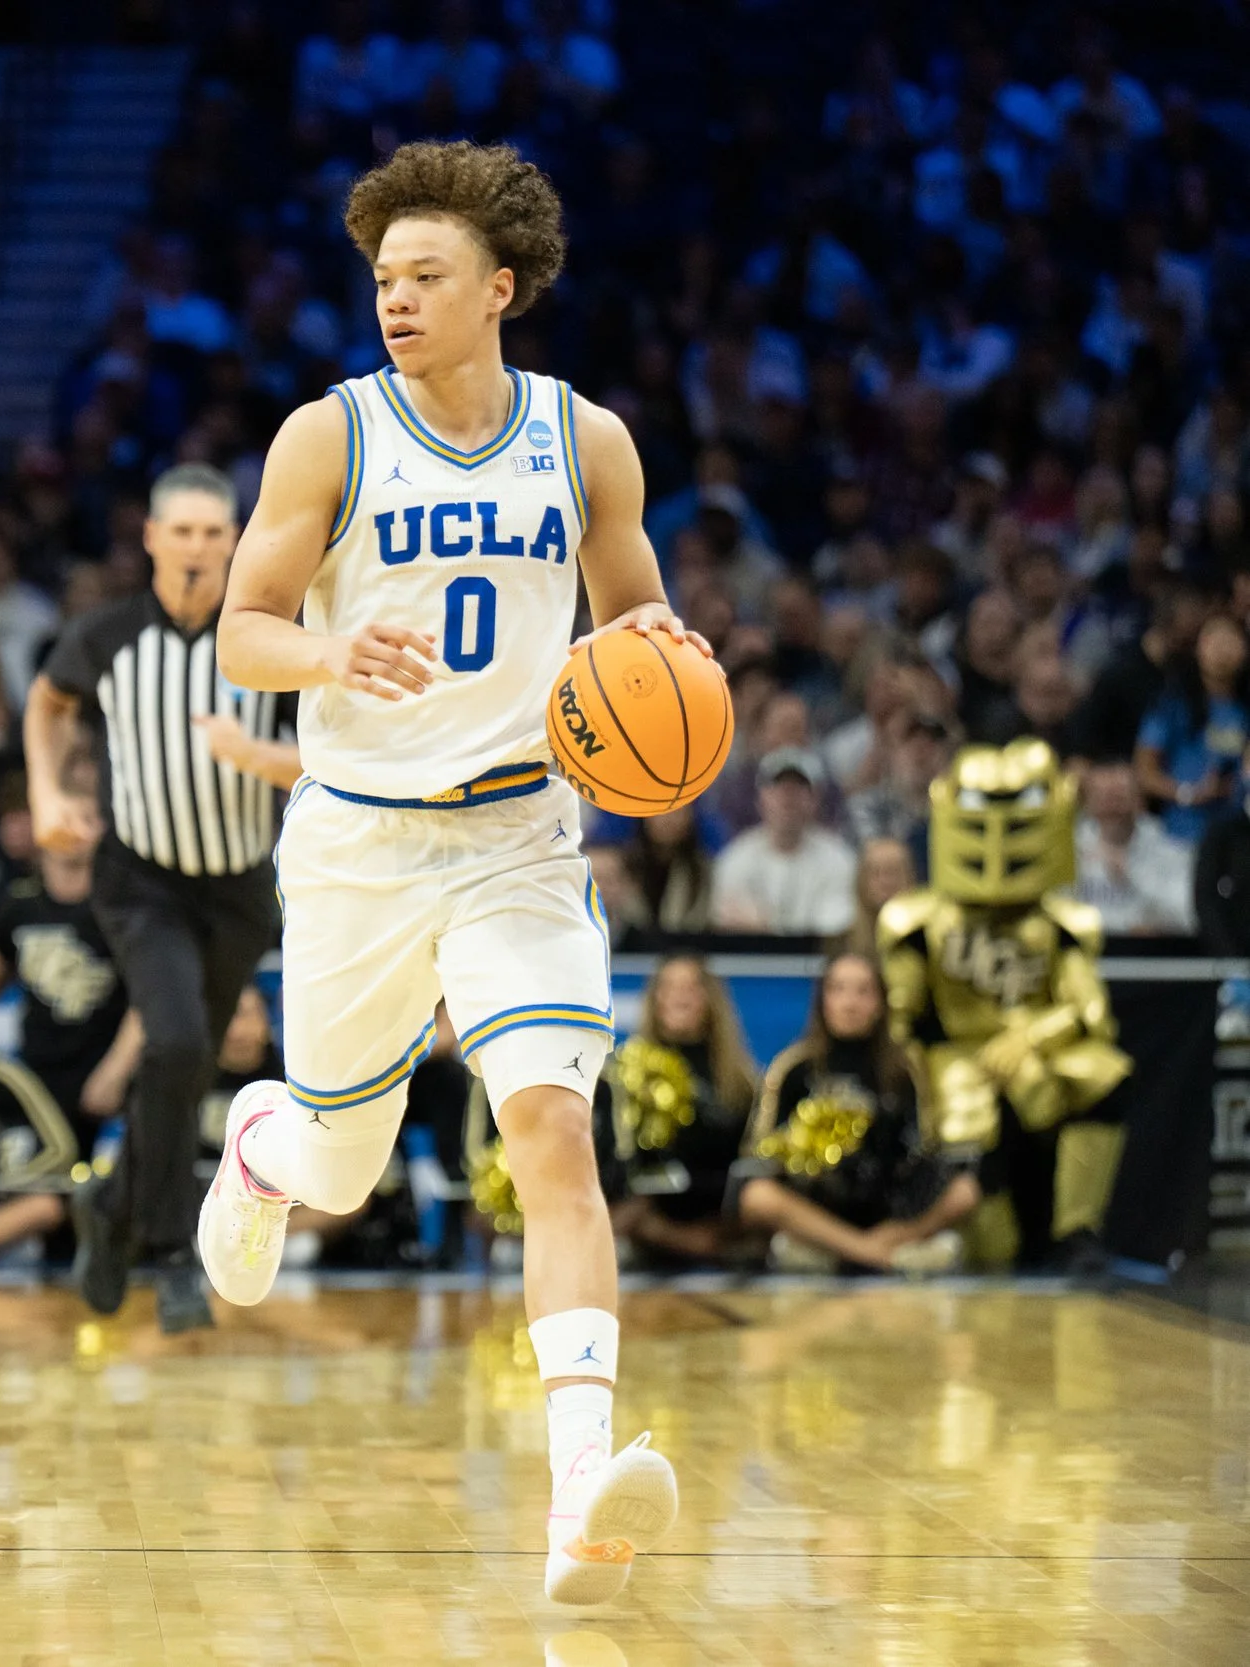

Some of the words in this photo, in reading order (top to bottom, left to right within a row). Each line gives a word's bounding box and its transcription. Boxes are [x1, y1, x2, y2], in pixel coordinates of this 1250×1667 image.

[375, 502, 567, 566] UCLA
[443, 577, 496, 672] 0
[558, 677, 605, 758] NCAA
